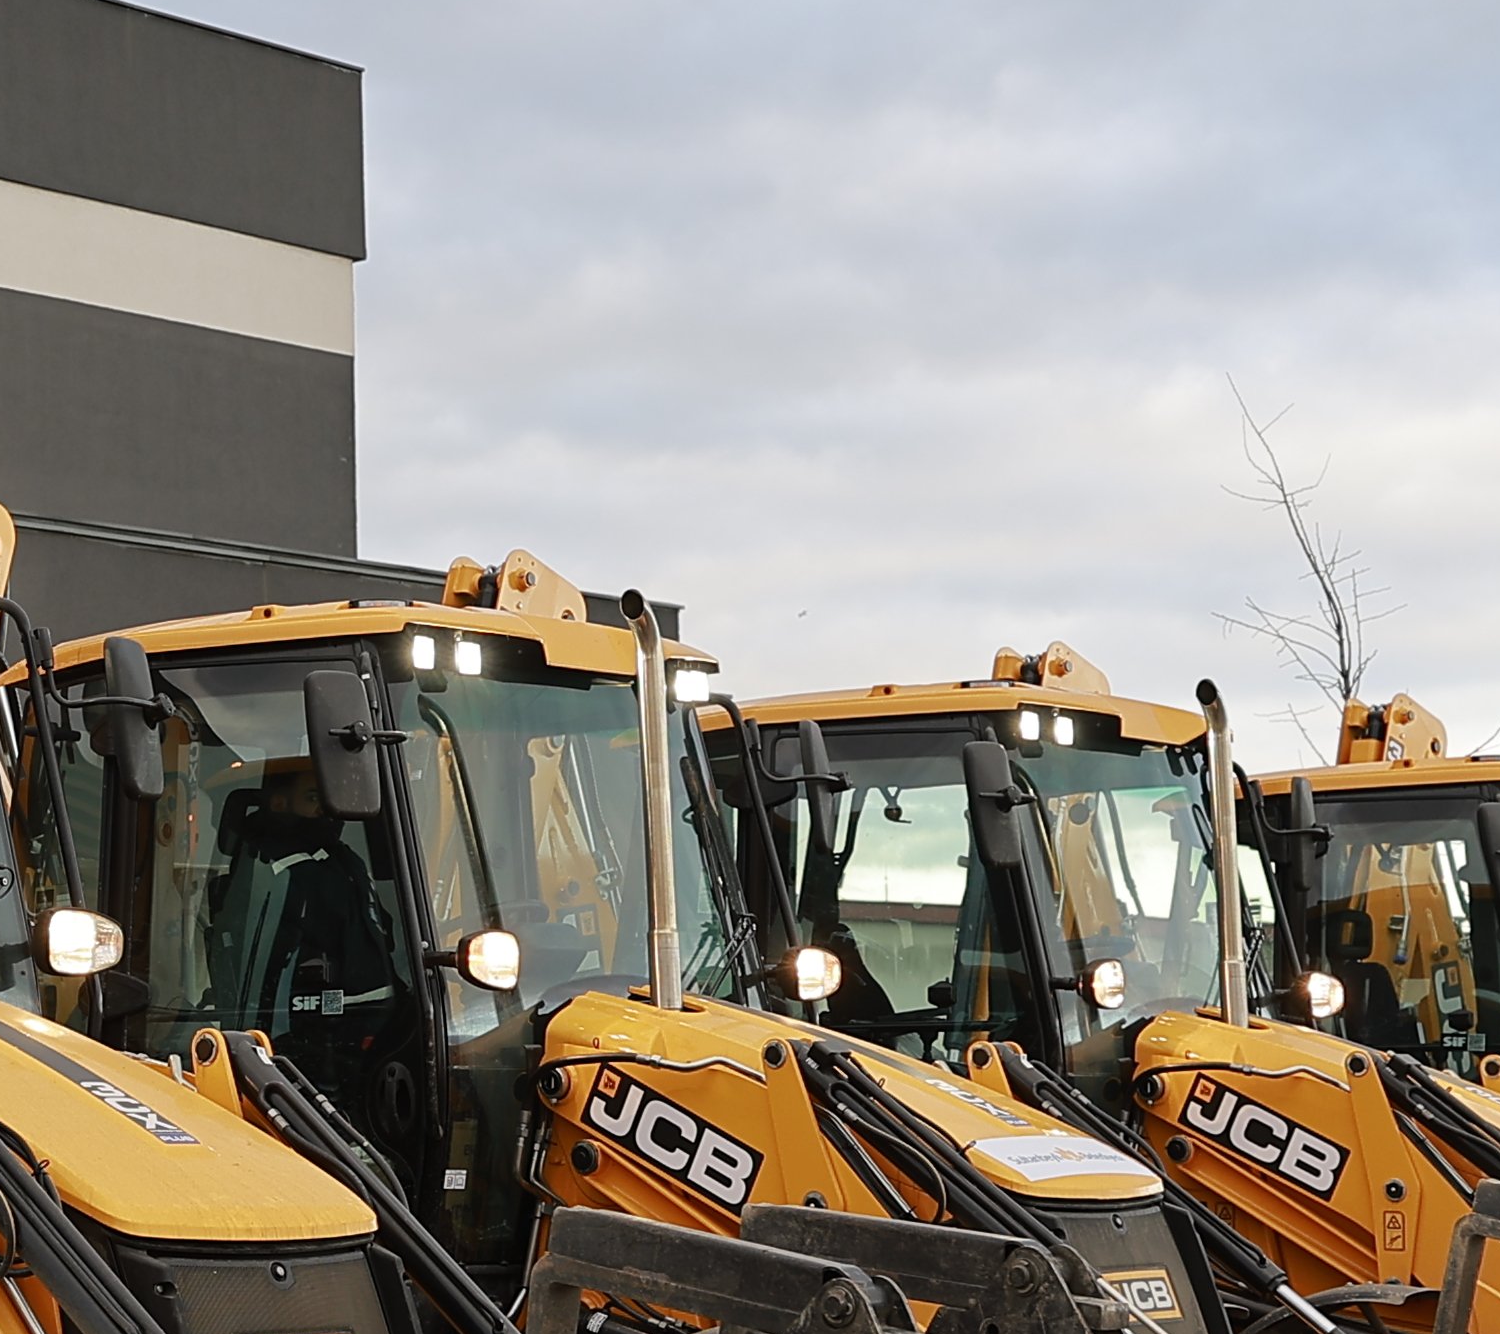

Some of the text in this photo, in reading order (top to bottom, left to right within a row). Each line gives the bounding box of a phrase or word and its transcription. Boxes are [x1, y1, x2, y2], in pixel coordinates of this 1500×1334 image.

[80, 1081, 178, 1130] 3CX
[589, 1083, 754, 1205] JCB
[1186, 1091, 1341, 1192] JCB
